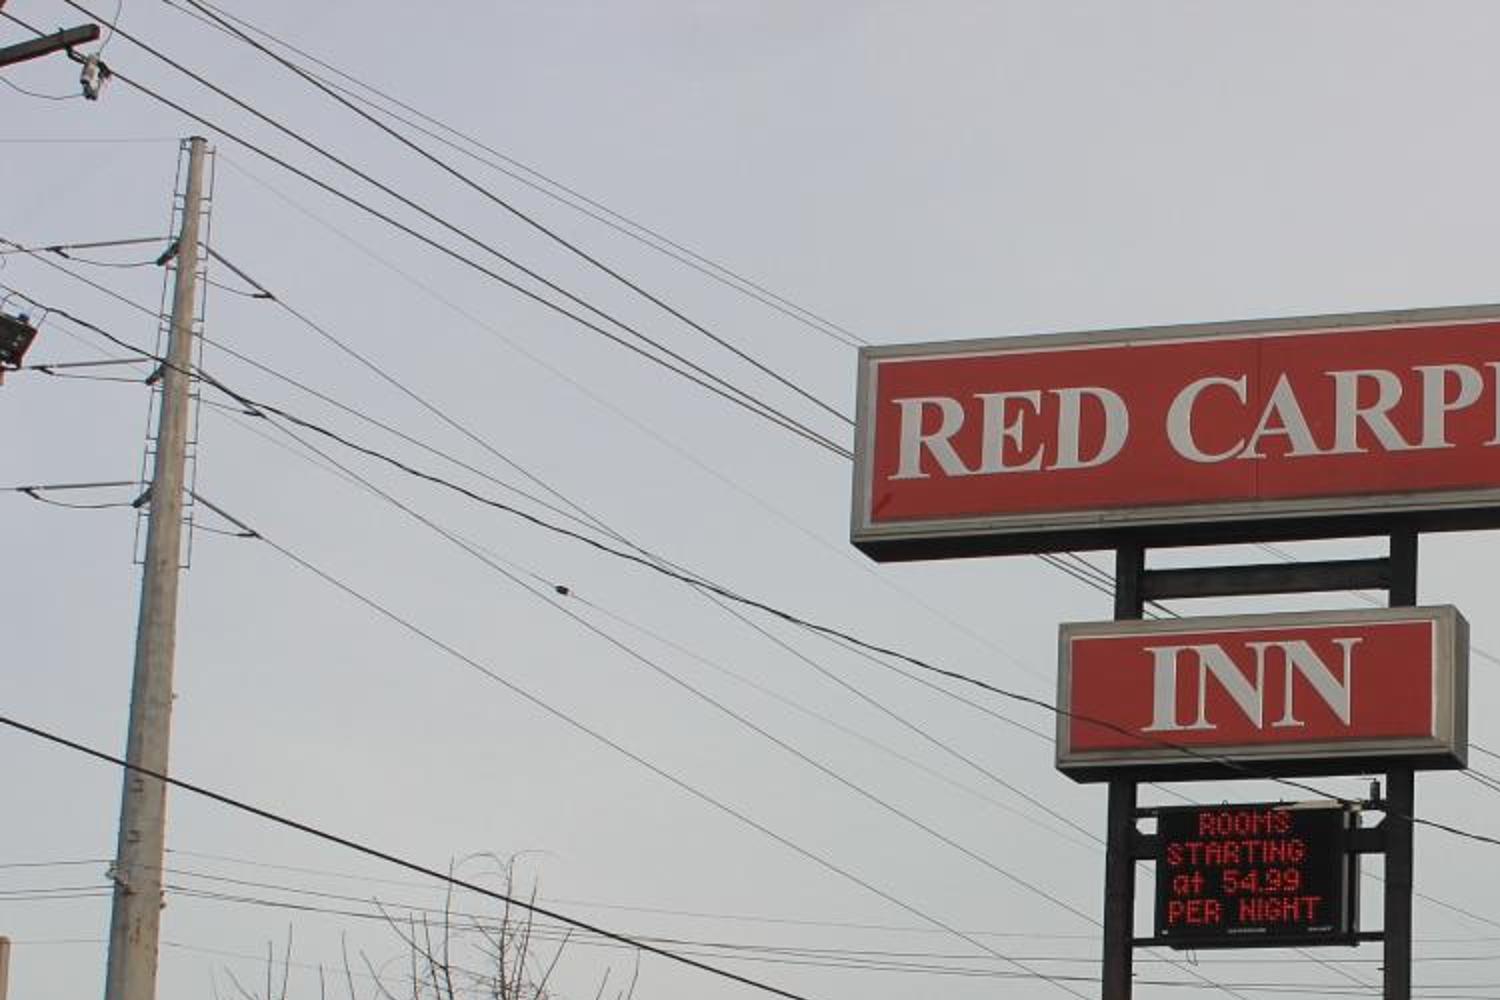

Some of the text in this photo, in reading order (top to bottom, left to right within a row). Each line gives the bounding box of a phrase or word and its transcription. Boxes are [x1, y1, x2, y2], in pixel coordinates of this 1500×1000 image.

[888, 386, 1130, 481] RED
[1140, 636, 1364, 733] INN
[1199, 810, 1292, 835] ROOMS
[1166, 839, 1306, 865] STARTING
[1172, 871, 1205, 894] at
[1168, 897, 1322, 924] PER NIGHT
